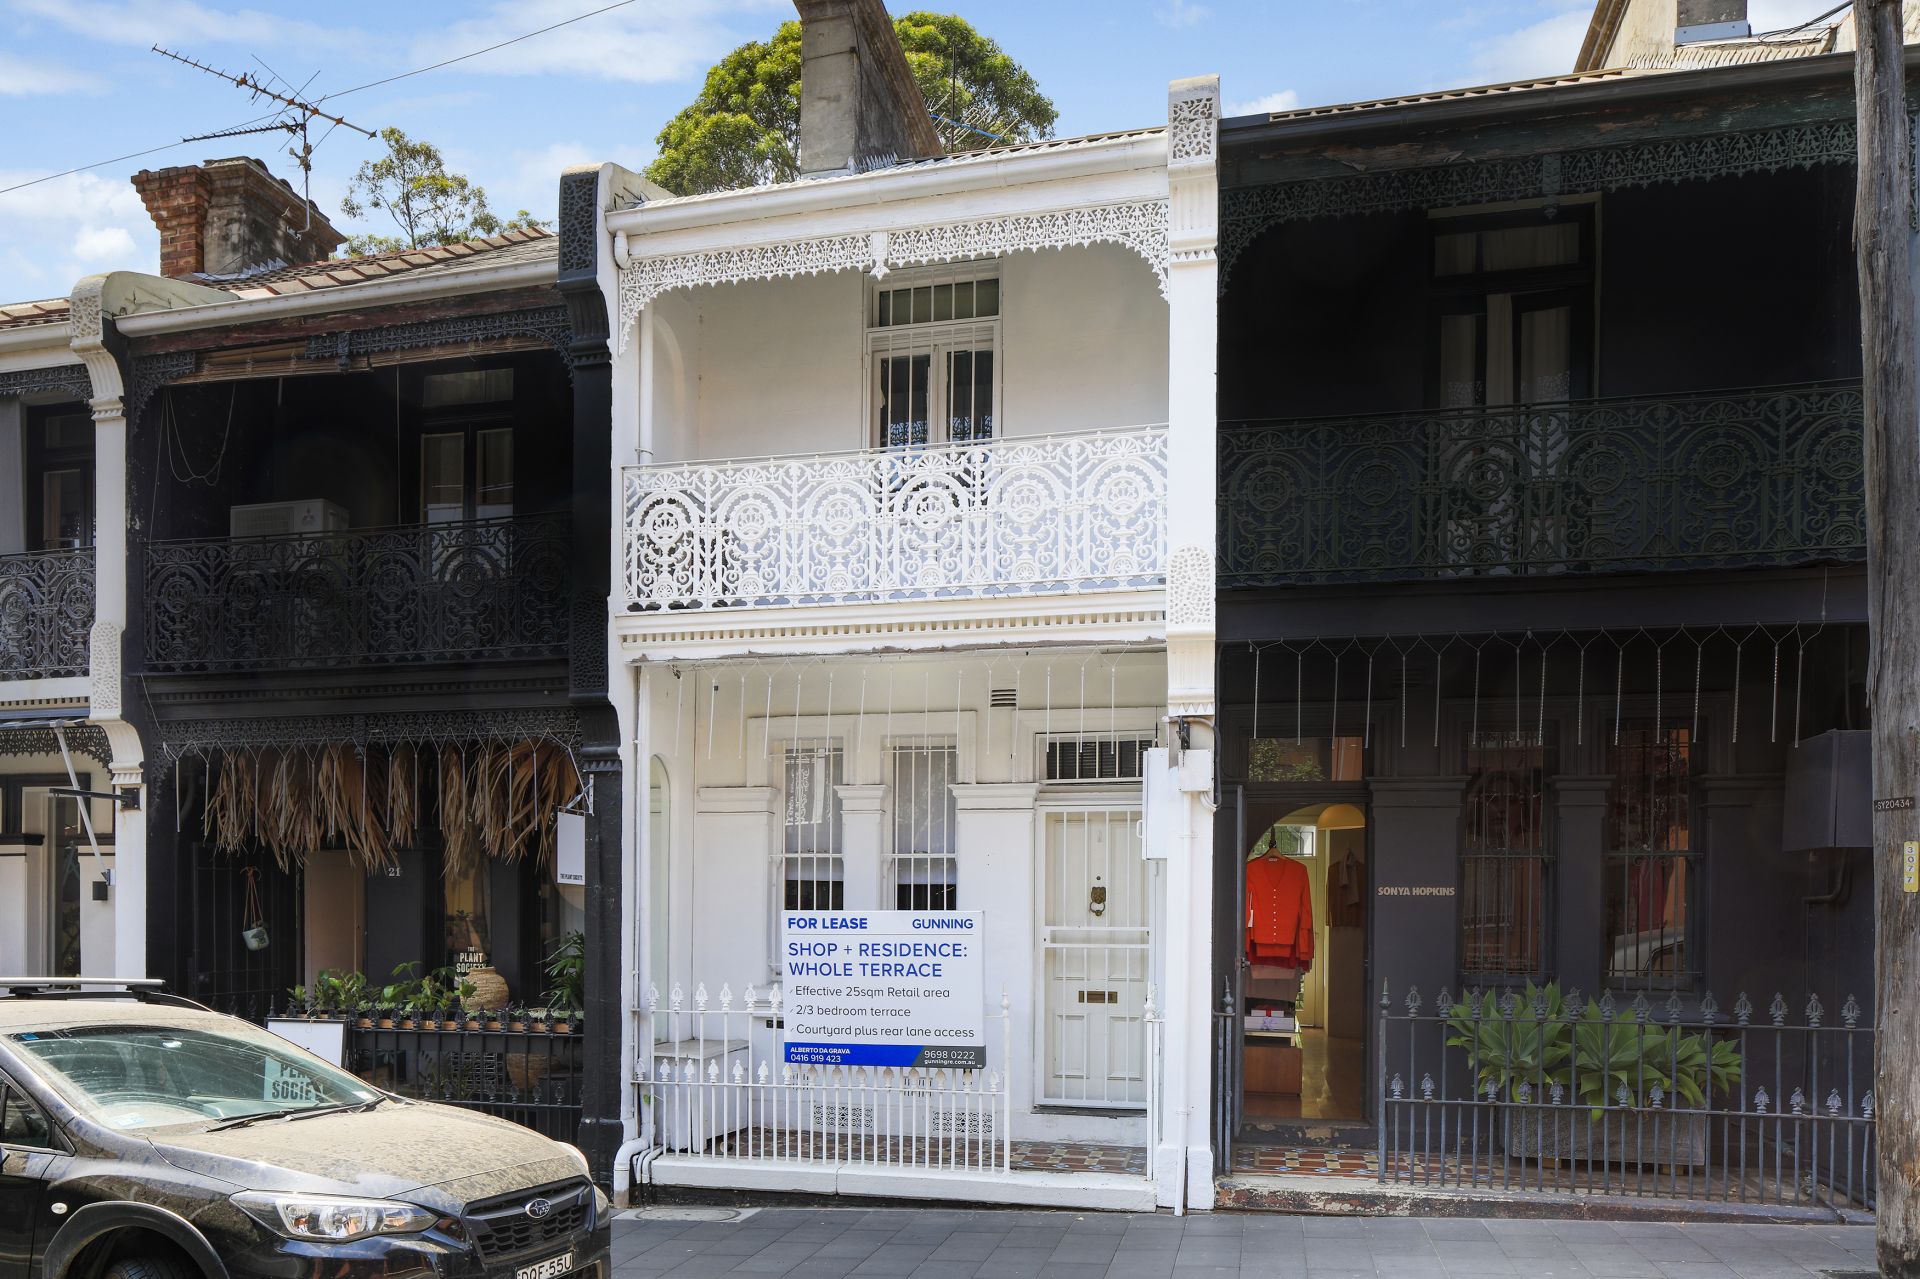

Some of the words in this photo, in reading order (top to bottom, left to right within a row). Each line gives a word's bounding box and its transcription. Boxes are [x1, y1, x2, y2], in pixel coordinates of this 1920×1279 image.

[388, 867, 401, 877] 21
[1377, 886, 1411, 896] SONYA
[1412, 887, 1455, 896] HOPKINS
[787, 917, 818, 929] FOR
[822, 917, 868, 930] LEASE
[912, 918, 974, 929] GUNNING
[788, 942, 838, 957] SHOP
[859, 943, 967, 957] RESIDENCE:
[459, 952, 484, 963] PLANT
[788, 962, 853, 977] WHOLE
[858, 963, 942, 977] TERRACE
[795, 985, 842, 996] Effective
[845, 986, 884, 999] 25sqm
[887, 987, 920, 998] Retail
[923, 989, 950, 998] area
[796, 1004, 814, 1015] 2/3
[817, 1005, 867, 1016] bedroom
[870, 1007, 911, 1017] terrace
[796, 1024, 852, 1037] Courtyard
[854, 1026, 878, 1037] plus
[880, 1027, 904, 1036] rear
[906, 1026, 932, 1037] lane
[934, 1029, 975, 1038] access
[790, 1054, 809, 1062] 0416
[825, 1055, 841, 1063] 423
[924, 1050, 949, 1059] 9698
[950, 1051, 975, 1060] 0222
[271, 1080, 314, 1101] SOCIE
